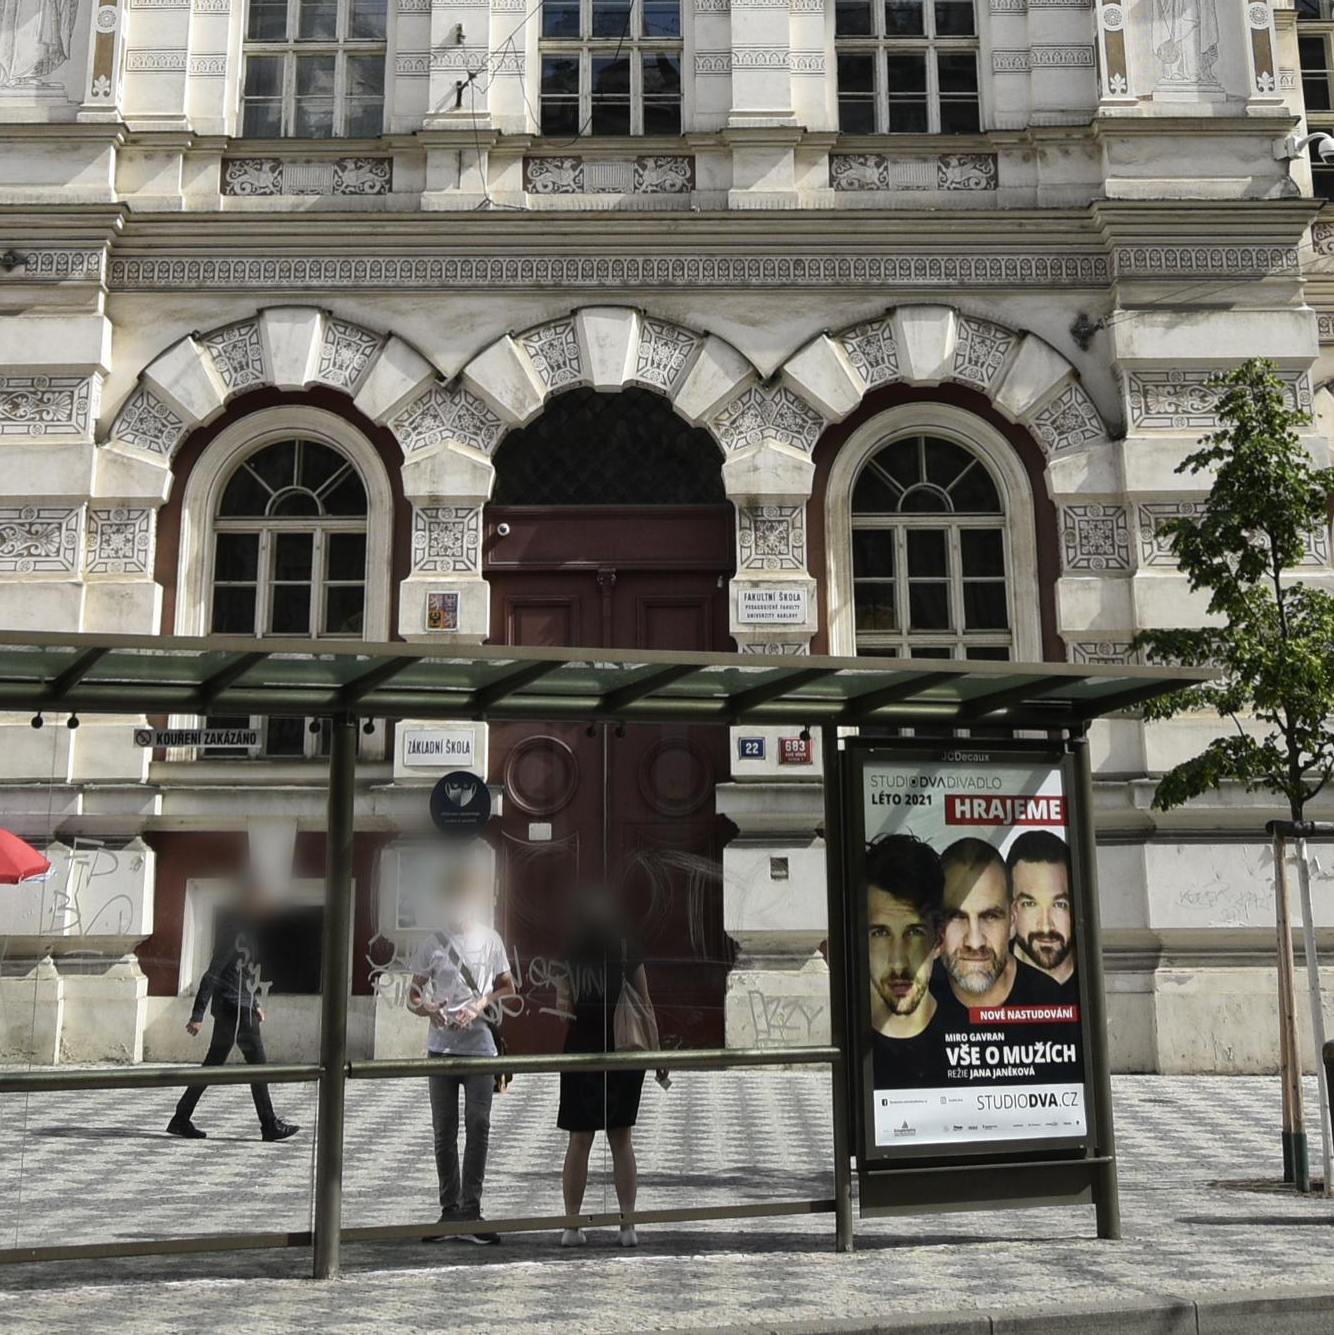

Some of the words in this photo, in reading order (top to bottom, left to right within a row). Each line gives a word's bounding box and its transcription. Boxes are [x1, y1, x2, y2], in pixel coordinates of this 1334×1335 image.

[744, 592, 776, 601] FAKULTNÍ
[779, 591, 801, 602] ŠKOLA
[156, 730, 201, 745] KOUŘENÍ
[204, 730, 257, 746] ZAKÁZÁNO
[408, 738, 443, 754] ZÁKLADNÍ
[446, 738, 470, 754] ŠKOLA
[745, 742, 759, 755] 22
[785, 740, 806, 752] 683
[941, 751, 990, 762] JCDecaux
[871, 791, 902, 806] LÉTO
[905, 793, 932, 806] 2021
[954, 798, 1062, 825] HRAJEME
[980, 1008, 1006, 1021] NOVÉ
[1007, 1007, 1073, 1020] NASTUDOVÁNÍ
[945, 1033, 967, 1042] MIRO
[969, 1032, 1005, 1042] GAVRAN
[946, 1043, 981, 1066] VŠE
[985, 1046, 1000, 1065] O
[1003, 1041, 1077, 1064] MUŽÍCH
[947, 1068, 969, 1079] REŽIE
[969, 1068, 992, 1080] JANA
[992, 1065, 1036, 1079] JANĚKOVÁ
[976, 1091, 1078, 1111] STUDIODVA.CZ
